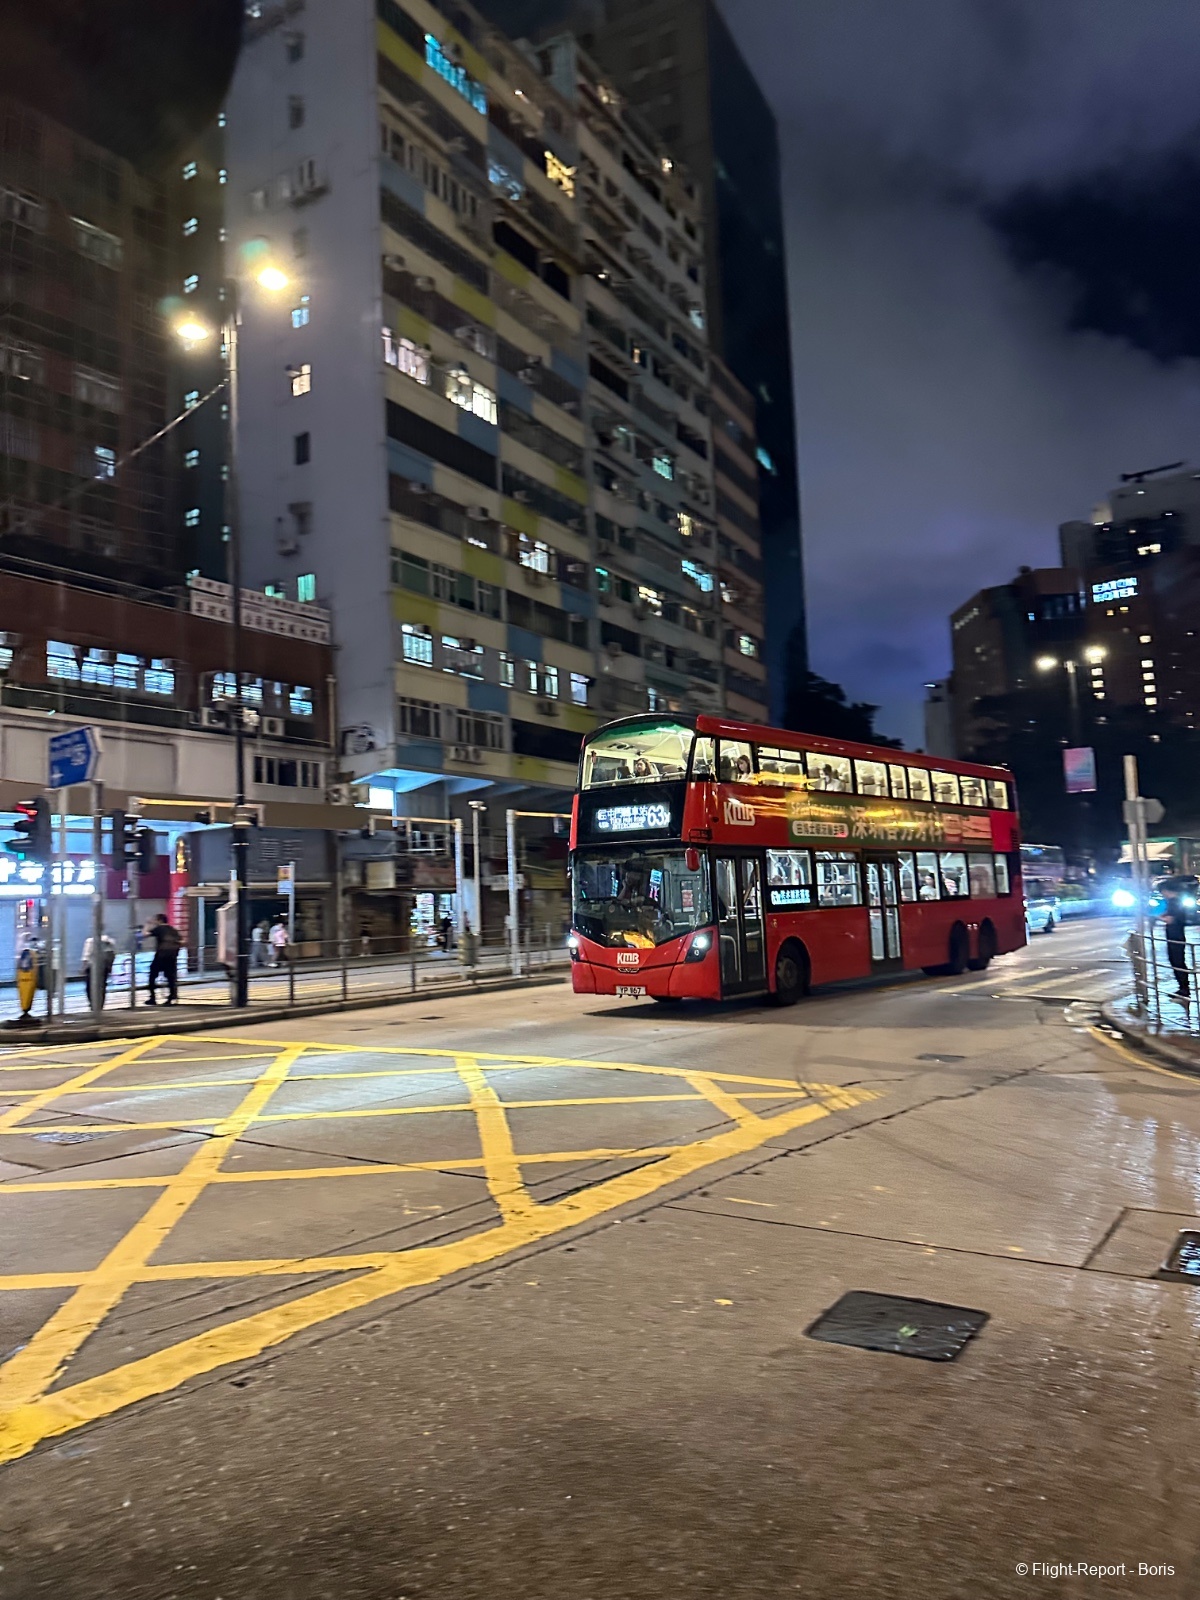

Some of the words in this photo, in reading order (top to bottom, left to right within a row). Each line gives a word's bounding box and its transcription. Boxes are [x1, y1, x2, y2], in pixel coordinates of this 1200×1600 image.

[1093, 587, 1138, 602] HOTEL
[723, 801, 755, 826] KMB
[617, 952, 640, 965] KMB
